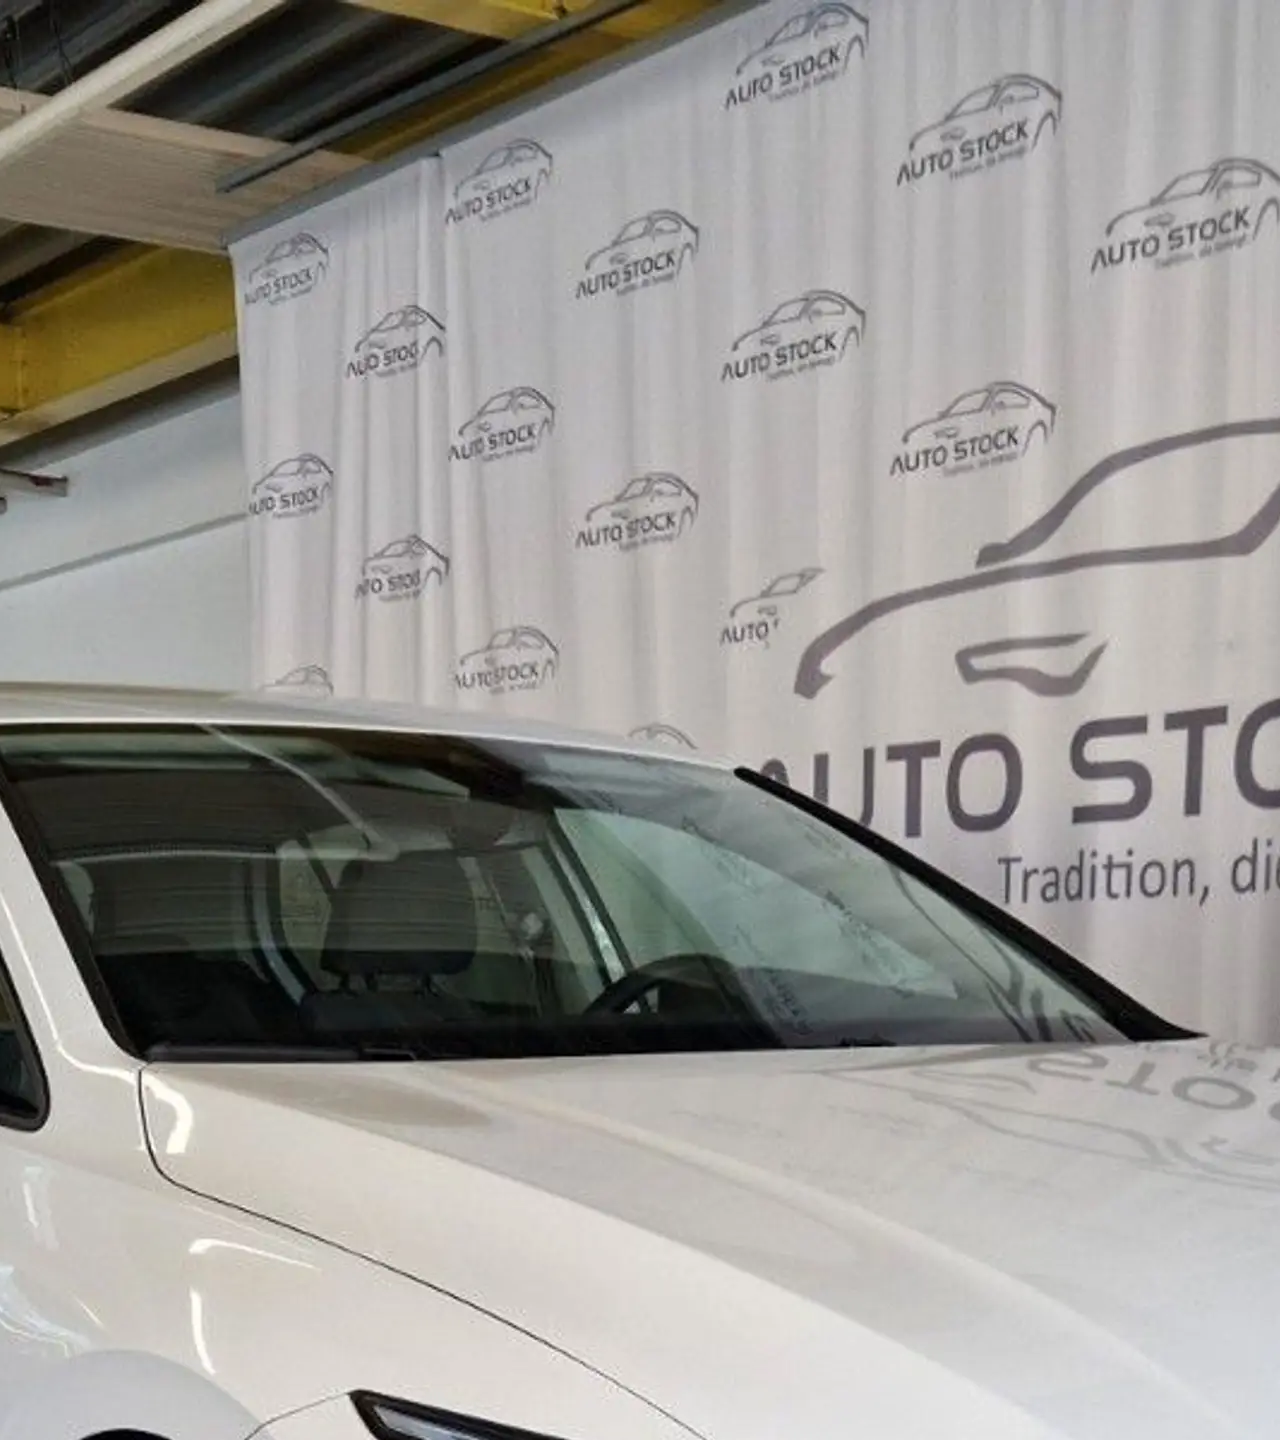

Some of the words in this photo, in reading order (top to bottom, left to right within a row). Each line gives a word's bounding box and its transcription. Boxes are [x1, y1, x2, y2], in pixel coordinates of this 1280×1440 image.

[724, 72, 772, 110] AUTO
[780, 42, 840, 86] STOCK
[897, 148, 953, 186] AUTO
[960, 117, 1028, 161] STOCK
[1091, 235, 1160, 275] AUTO
[1168, 205, 1250, 250] STOCK
[576, 269, 619, 299] AUTO
[623, 248, 675, 283] STOCK
[721, 352, 769, 383] AUTO
[776, 329, 837, 366] STOCK
[488, 422, 536, 450] STOCK
[890, 444, 948, 476] AUTO
[953, 425, 1019, 462] STOCK
[575, 524, 622, 548] AUTO
[626, 511, 675, 538] STOCK
[720, 621, 769, 646] AUTO
[997, 847, 1211, 908] Tradition,
